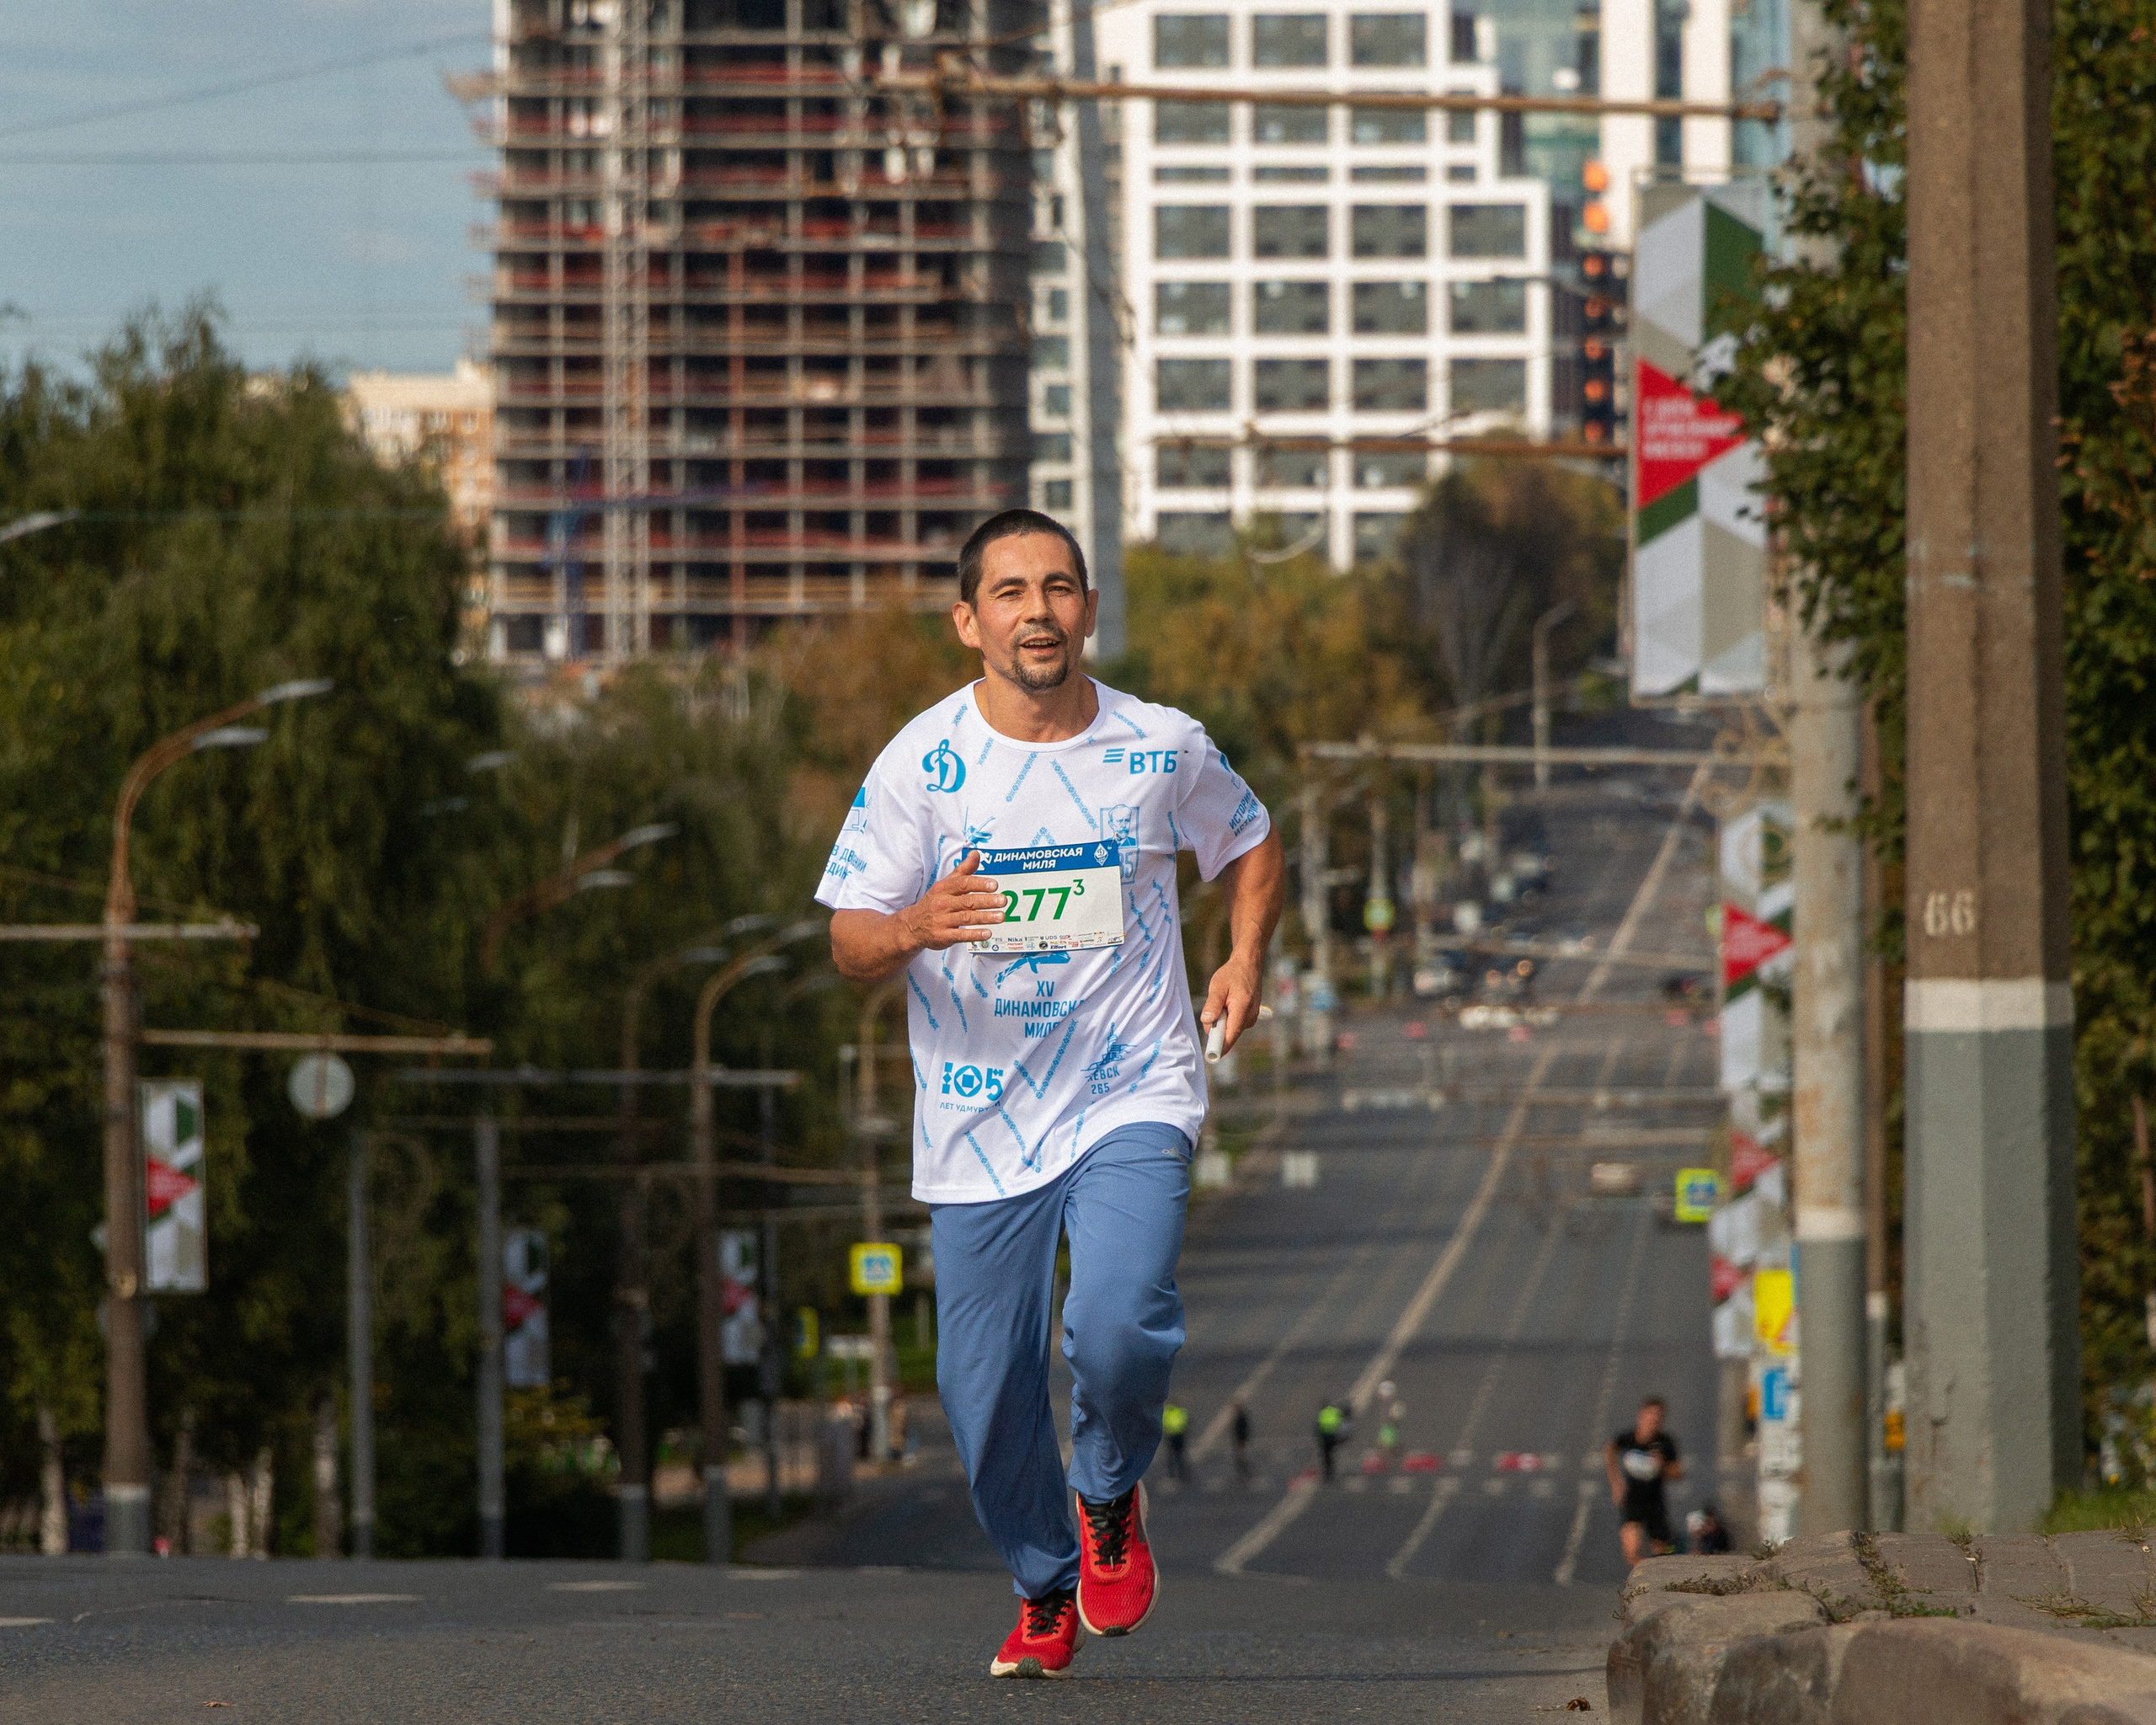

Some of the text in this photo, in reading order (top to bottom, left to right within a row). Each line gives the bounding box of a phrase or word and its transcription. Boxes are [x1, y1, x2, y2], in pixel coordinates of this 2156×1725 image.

[1129, 750, 1178, 774] ВТБ
[994, 846, 1083, 862] ДИНАМОВСКАЯ
[1022, 859, 1056, 871] МИЛЯ
[1000, 887, 1072, 922] 277
[1036, 980, 1055, 997] XV
[994, 998, 1085, 1017] ДИНАМОВСК
[1091, 1082, 1110, 1094] 265
